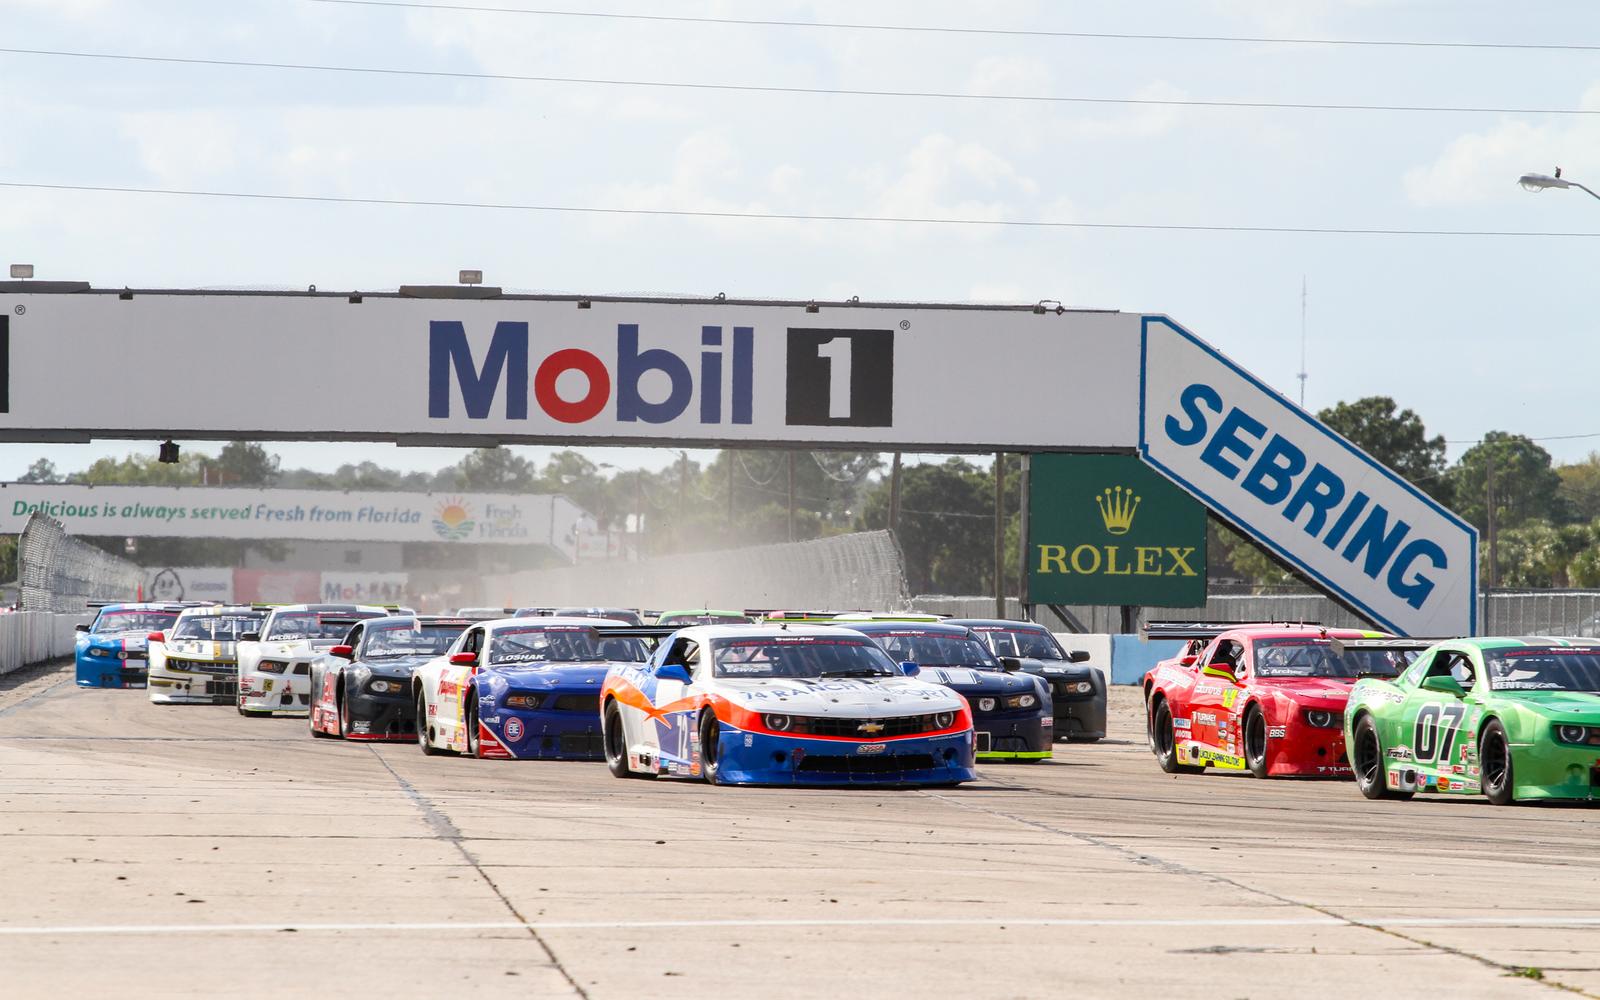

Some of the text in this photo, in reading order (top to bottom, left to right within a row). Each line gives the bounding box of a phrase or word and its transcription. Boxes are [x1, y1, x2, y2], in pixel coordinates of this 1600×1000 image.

[429, 320, 851, 424] Mobil 1
[1164, 383, 1448, 610] SEBRING
[12, 500, 421, 524] Delicious is always served Fresh from Florida
[485, 503, 522, 519] Fresh
[479, 522, 528, 538] Florida
[1037, 544, 1198, 576] ROLEX
[498, 654, 545, 662] LOSHAK
[772, 683, 860, 698] RANCH
[1269, 729, 1286, 738] BBS
[1415, 703, 1466, 764] 07
